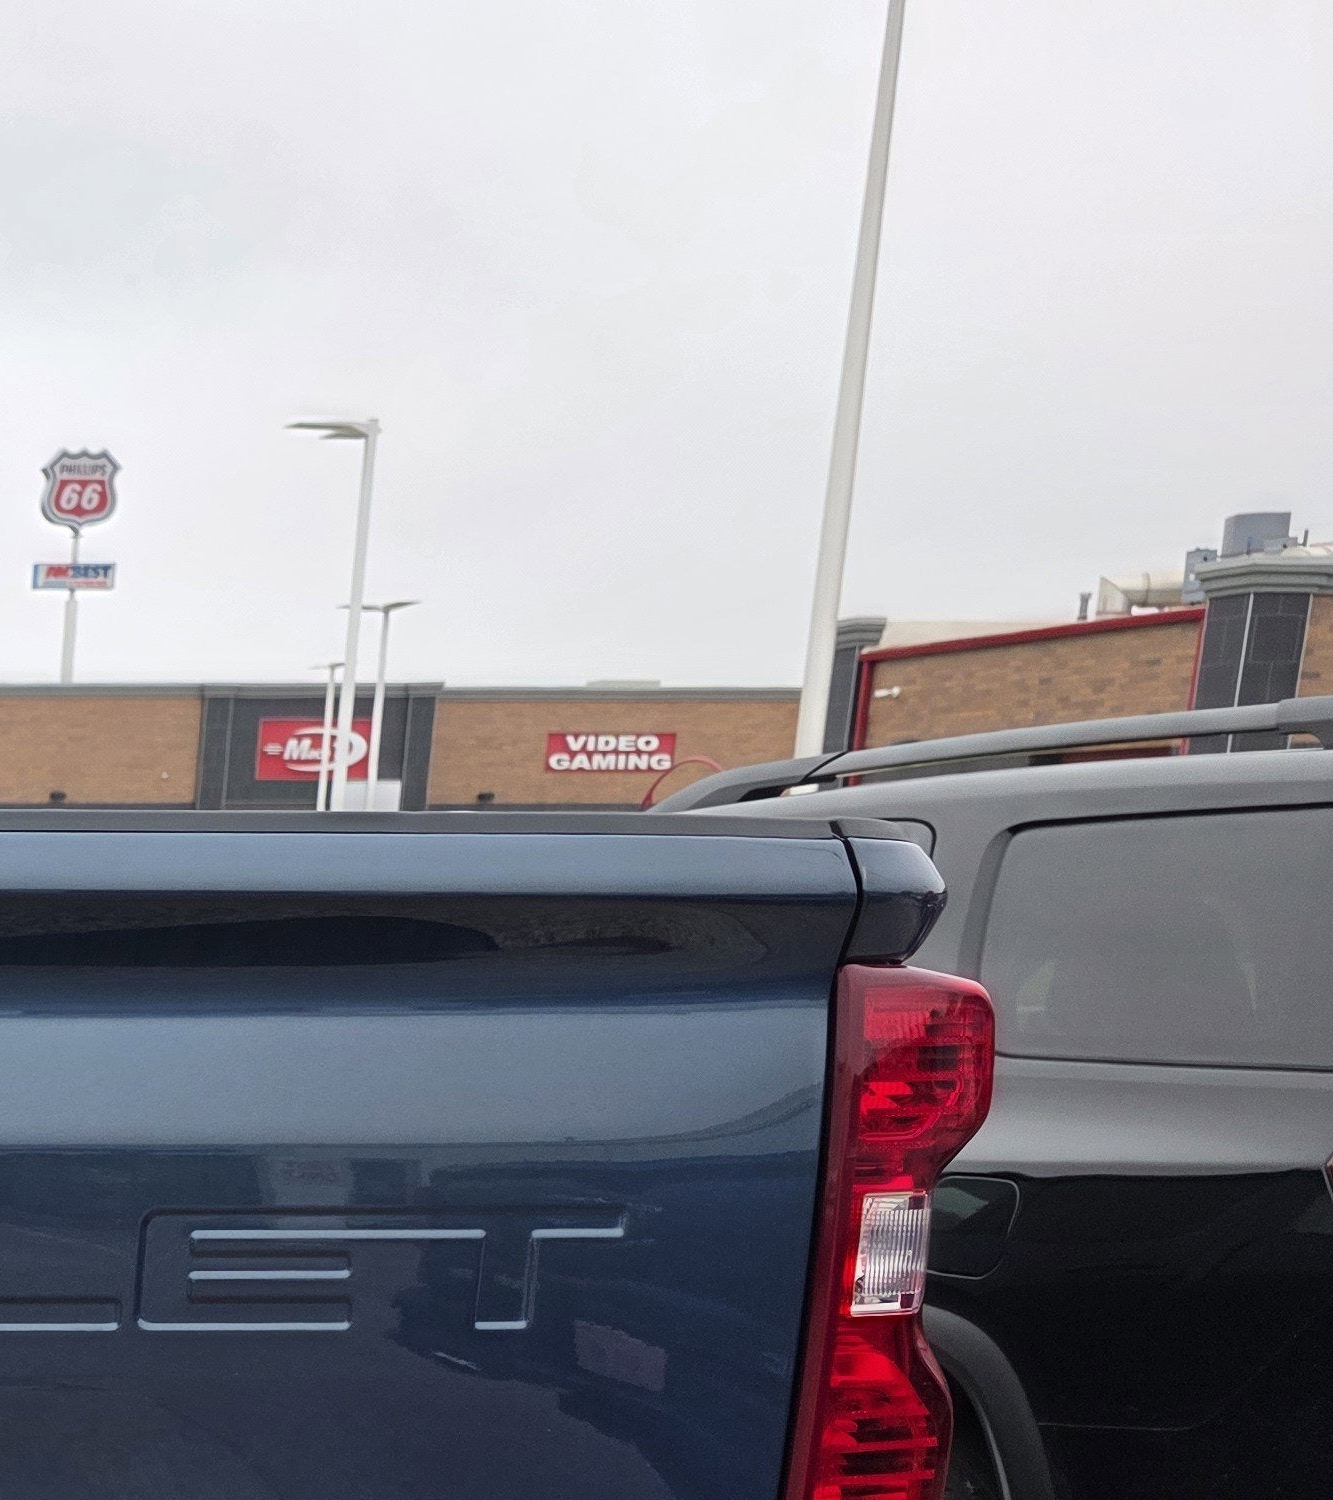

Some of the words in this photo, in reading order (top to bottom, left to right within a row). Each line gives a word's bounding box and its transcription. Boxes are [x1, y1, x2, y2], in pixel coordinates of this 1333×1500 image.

[58, 482, 103, 511] 66
[565, 734, 660, 752] VIDEO
[548, 753, 672, 771] GAMING
